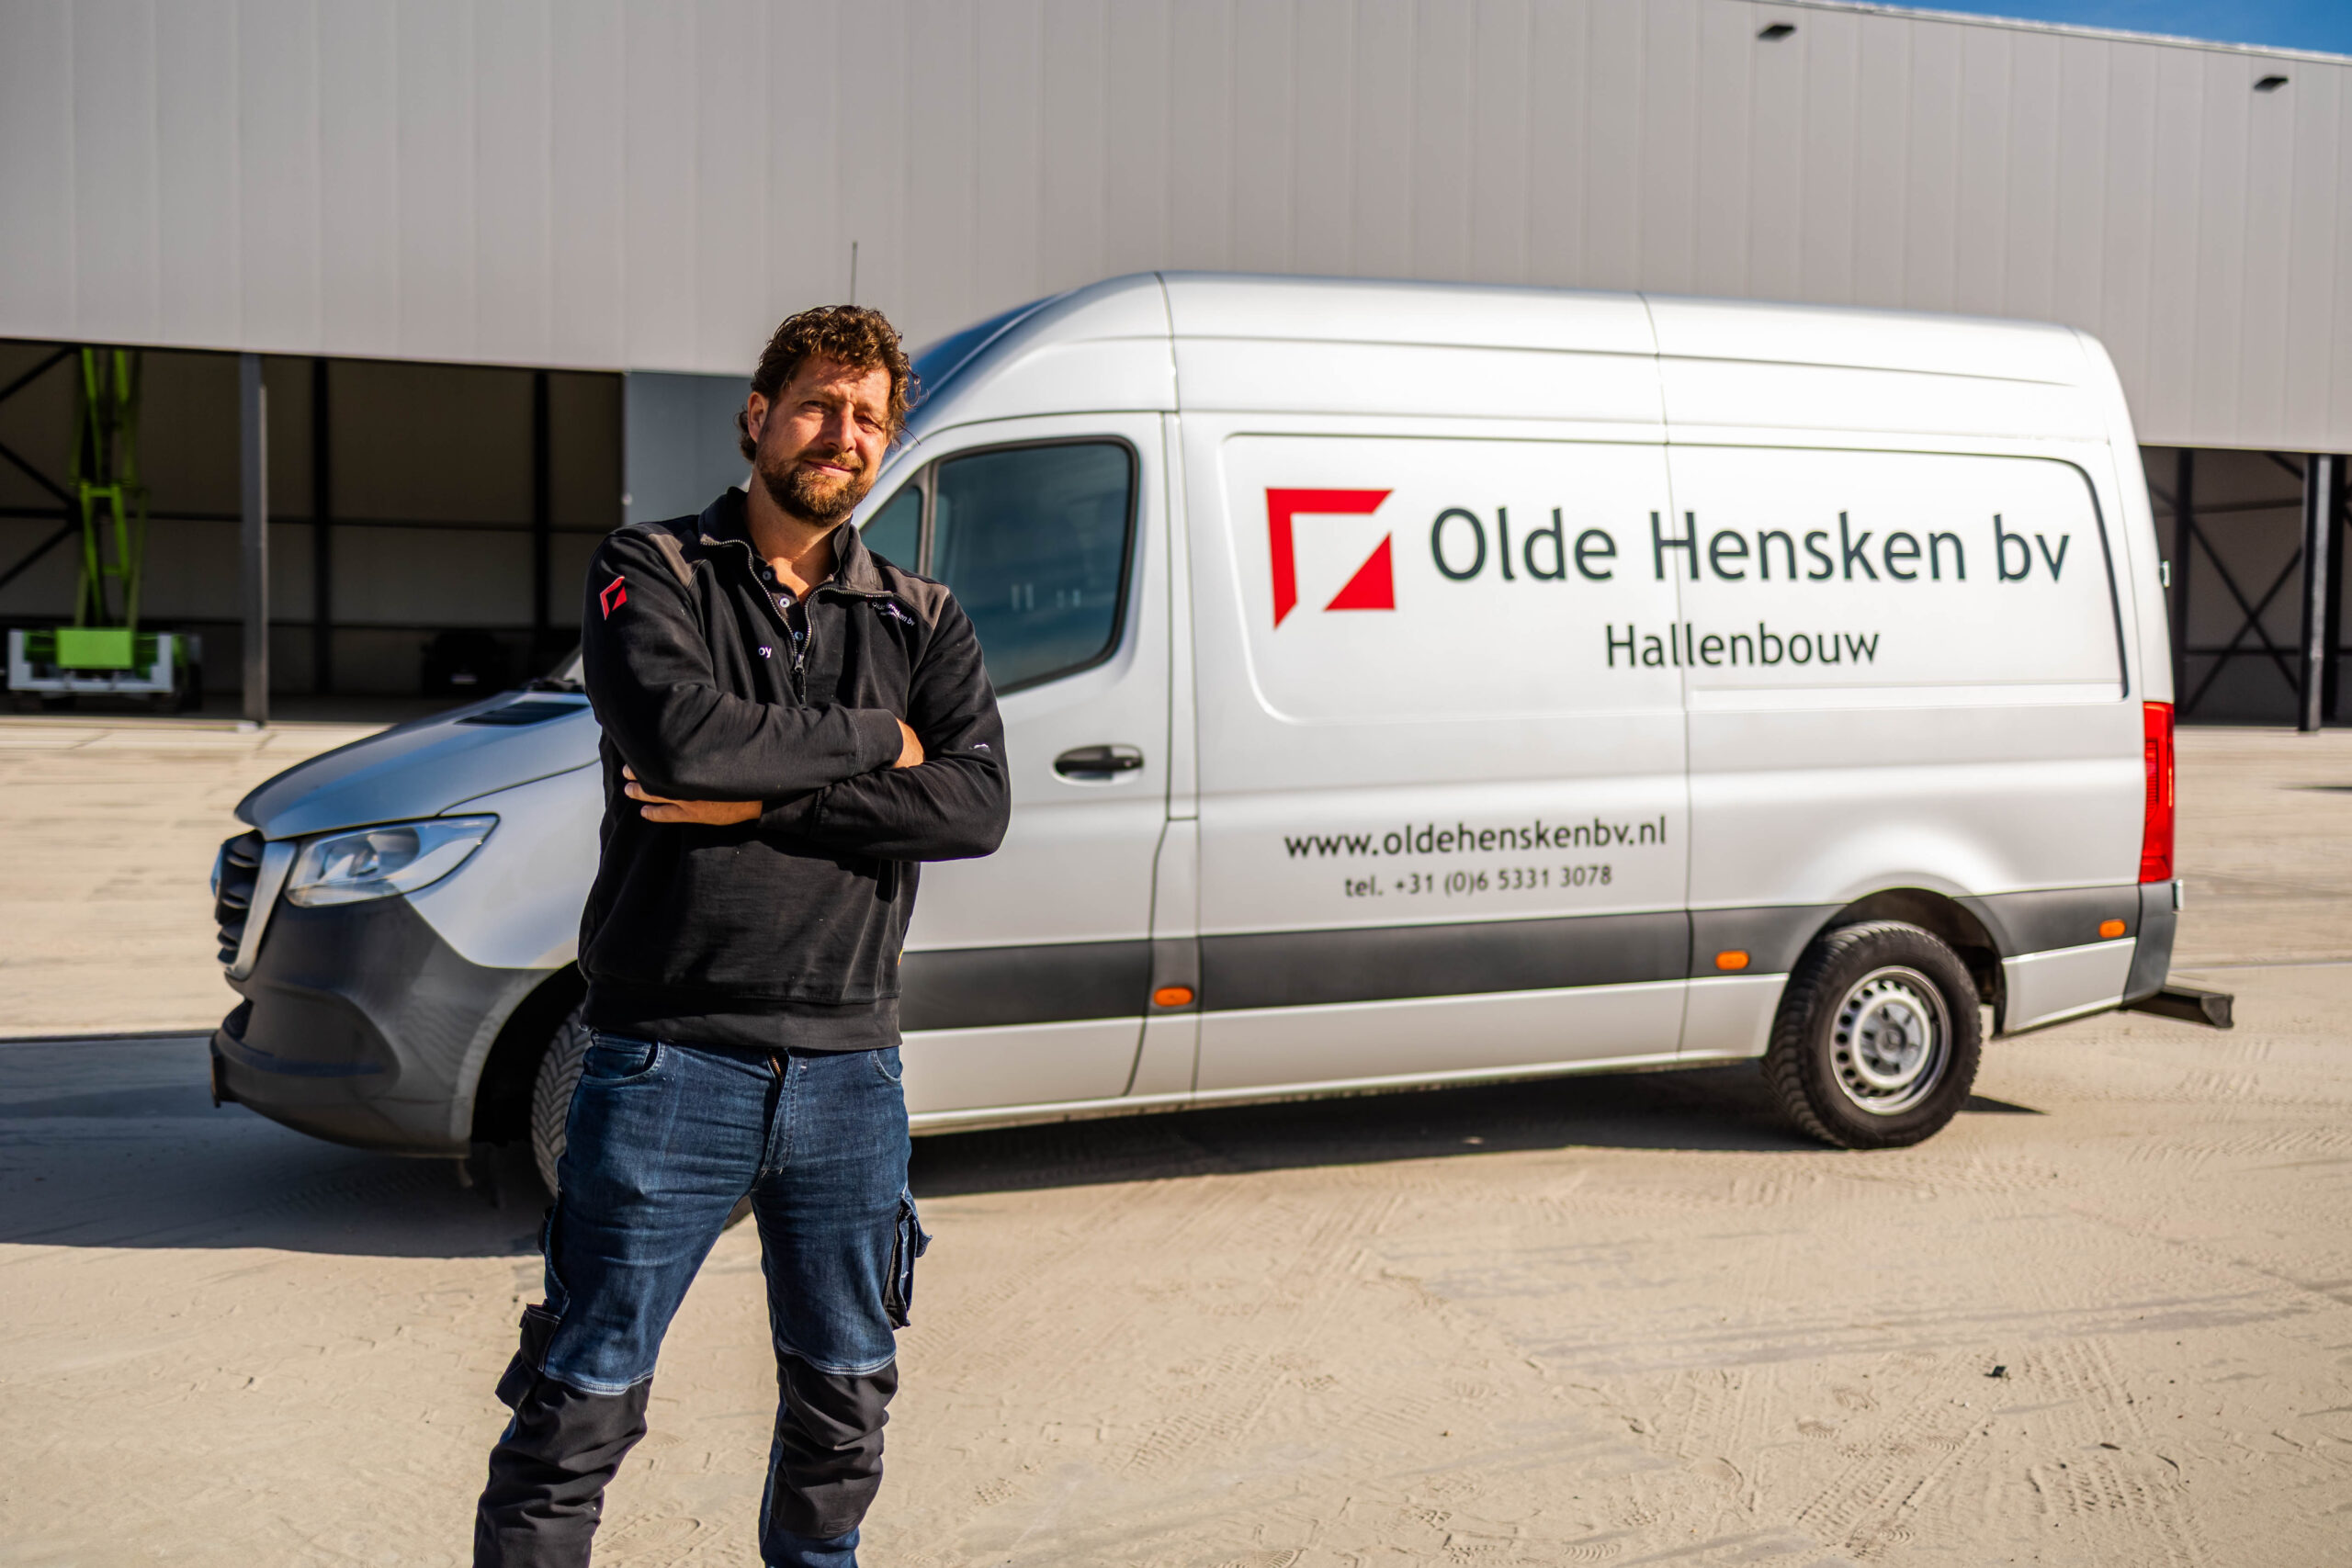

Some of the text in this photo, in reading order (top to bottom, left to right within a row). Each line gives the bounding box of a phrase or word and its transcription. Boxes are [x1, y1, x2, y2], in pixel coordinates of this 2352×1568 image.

[1430, 506, 2071, 582] Olde Hensken bv
[758, 647, 772, 659] oy
[1605, 621, 1881, 669] Hallenbouw
[1283, 815, 1668, 859] www.oldehenskenbv.nl
[1343, 864, 1613, 897] tel. +31 (0)6 5331 3078
